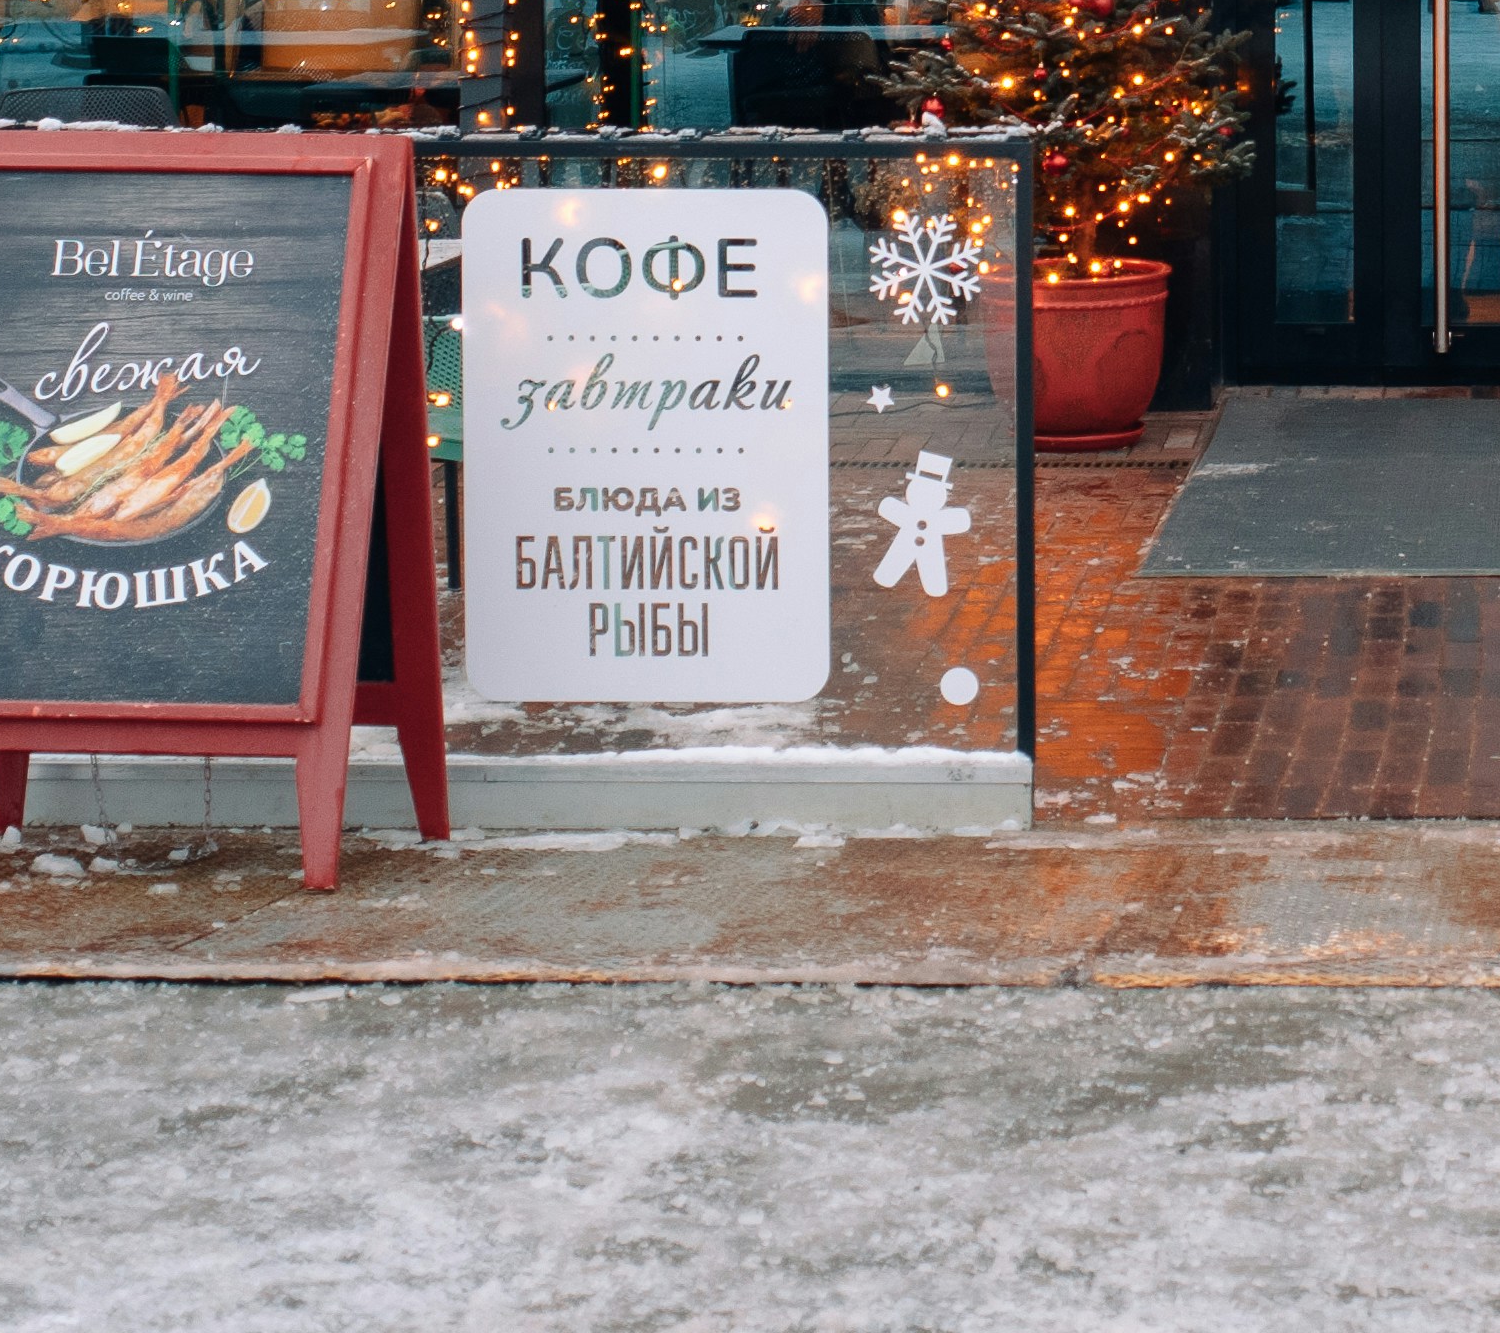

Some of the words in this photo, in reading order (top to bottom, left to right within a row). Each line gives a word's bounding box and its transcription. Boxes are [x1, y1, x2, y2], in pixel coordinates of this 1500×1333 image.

[51, 239, 118, 279] Bel
[132, 230, 255, 287] Étage
[520, 235, 759, 300] КОФЕ
[104, 288, 145, 303] coffee
[148, 289, 160, 302] &
[162, 289, 193, 303] wine
[33, 321, 263, 402] свежая
[499, 352, 794, 432] завтраки
[553, 486, 687, 517] БЛЮДА
[697, 486, 741, 513] ИЗ
[515, 525, 779, 591] БАЛТИЙСКОЙ
[588, 601, 711, 659] РЫБЫ
